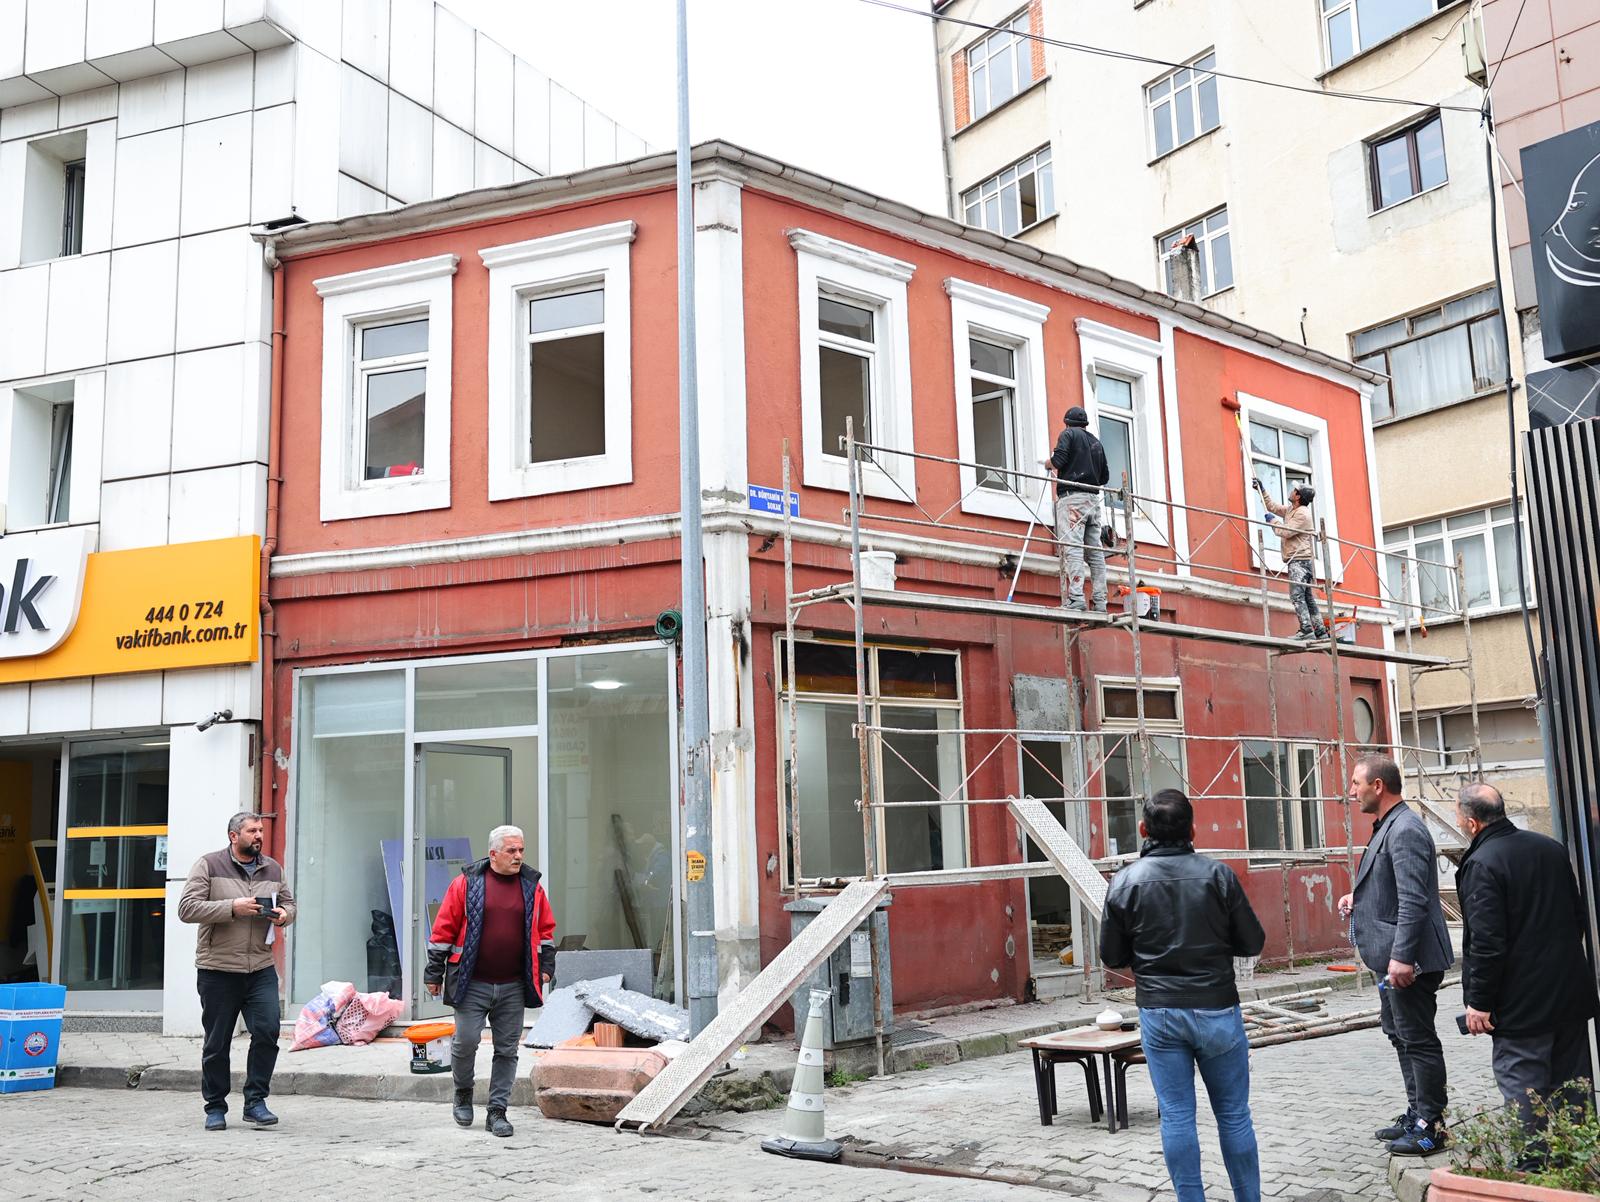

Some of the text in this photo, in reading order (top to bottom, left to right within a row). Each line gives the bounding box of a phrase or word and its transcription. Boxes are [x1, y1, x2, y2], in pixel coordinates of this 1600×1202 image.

[767, 502, 782, 511] SOKAK
[145, 600, 224, 624] 444 0 724
[116, 622, 248, 650] vakifbank.com.tr
